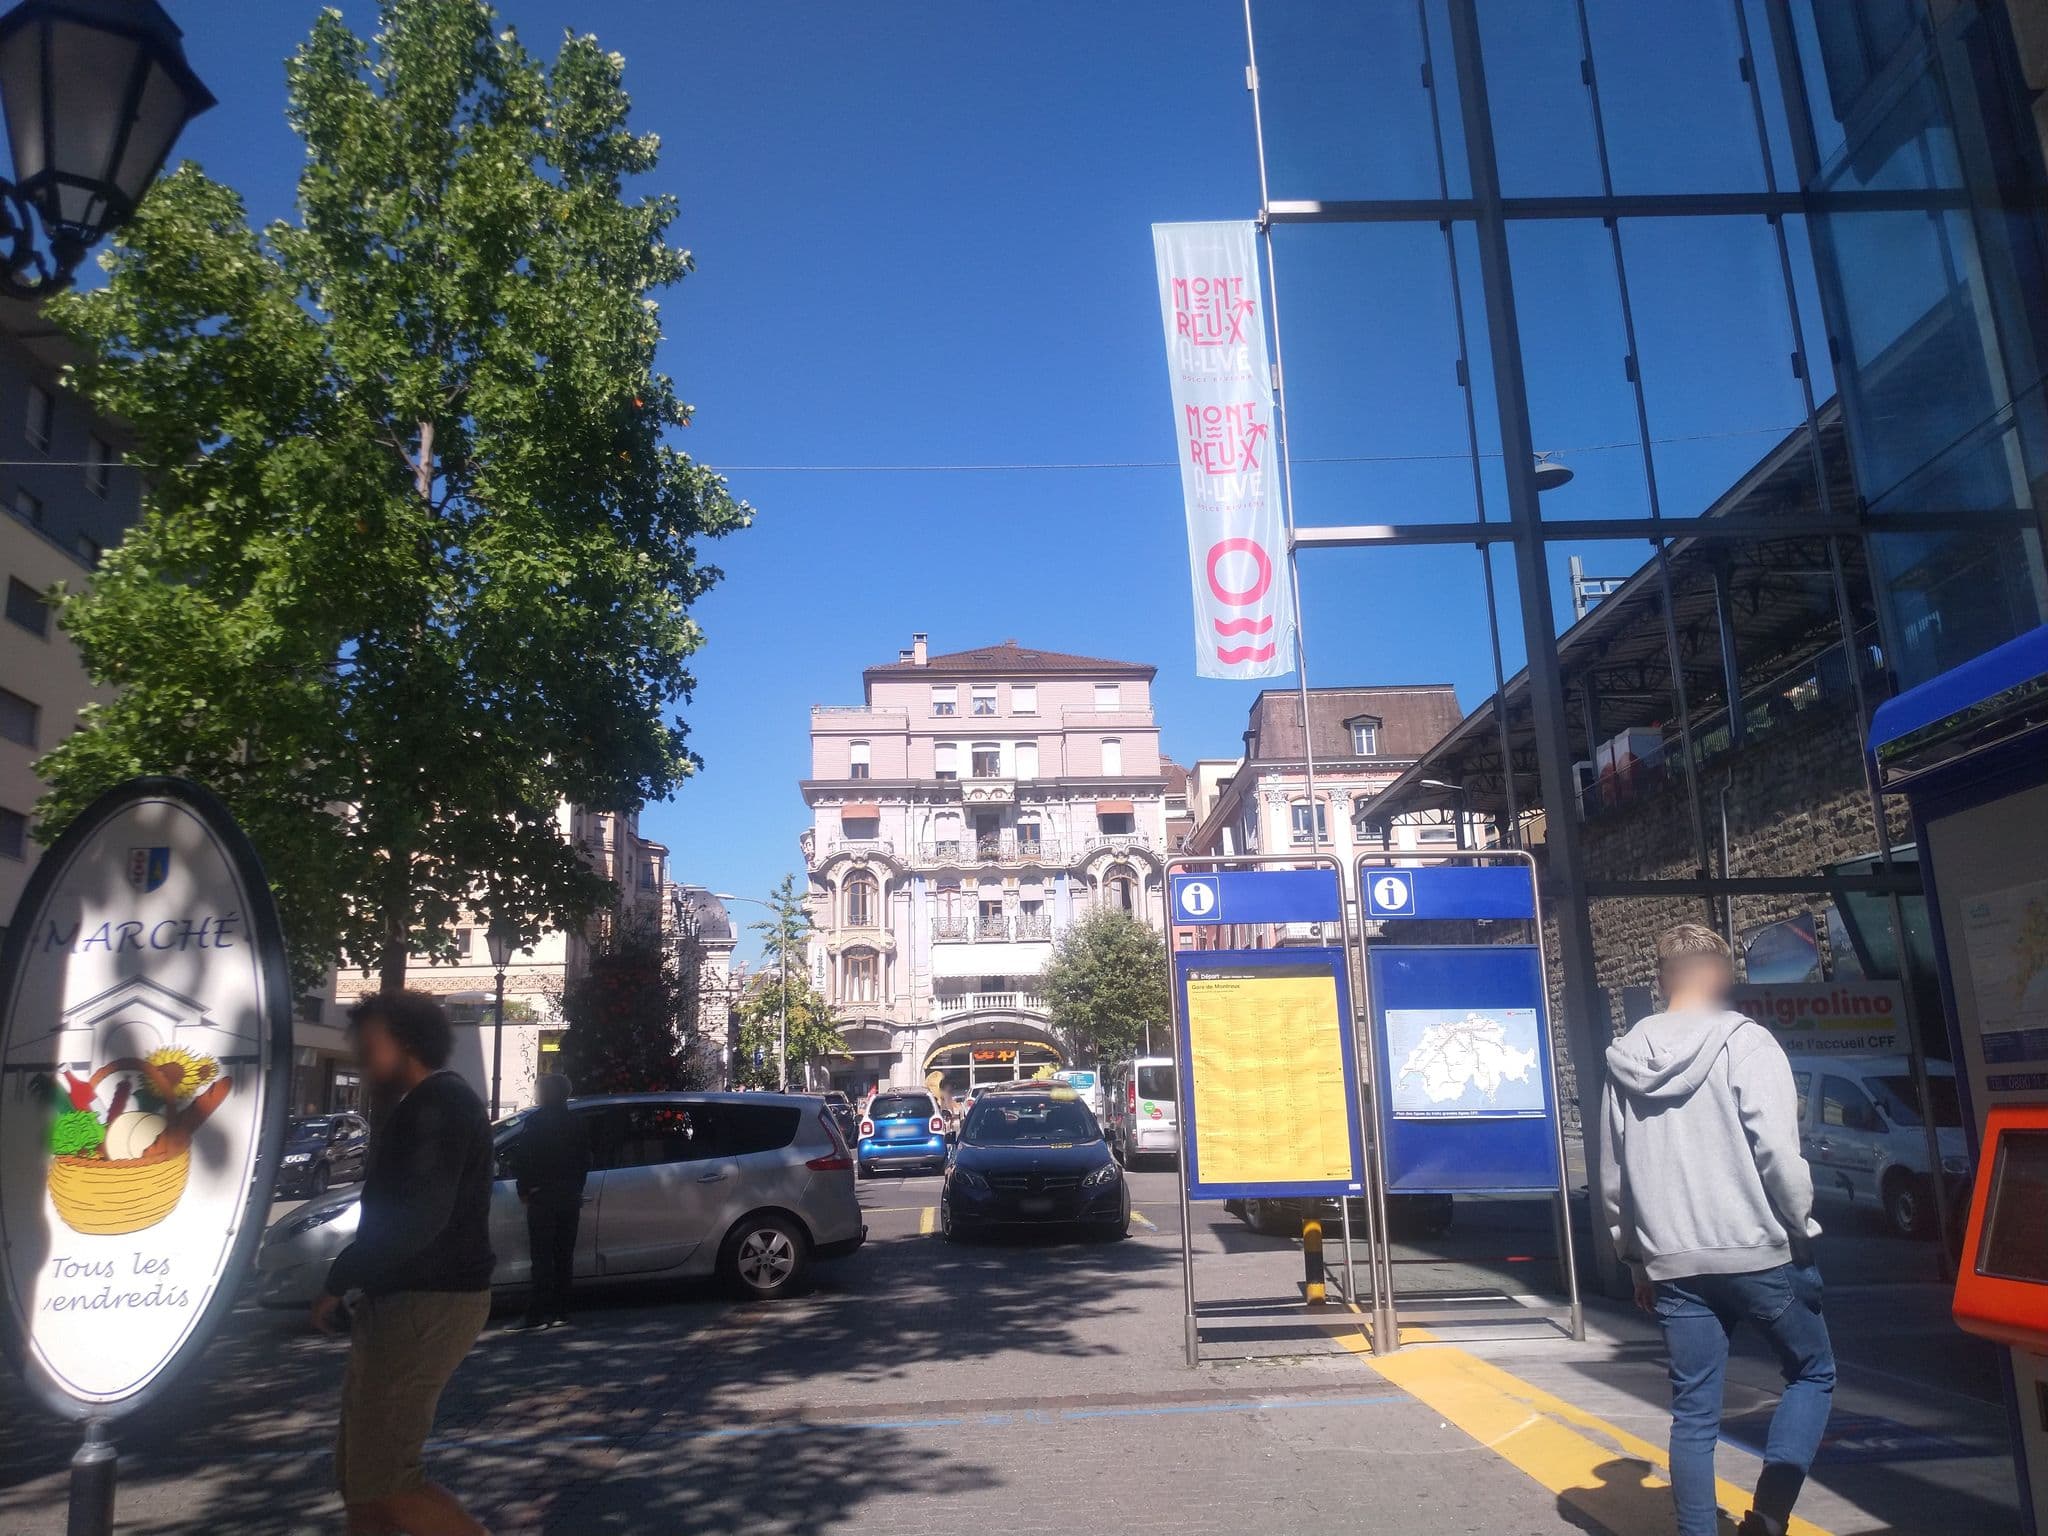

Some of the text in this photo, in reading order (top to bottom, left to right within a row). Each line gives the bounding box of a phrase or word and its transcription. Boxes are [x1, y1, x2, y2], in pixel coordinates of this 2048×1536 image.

[1171, 277, 1244, 310] MONT
[1185, 402, 1256, 439] MONT
[46, 912, 241, 954] MARCHÉ
[1736, 988, 1893, 1025] migrolino
[1787, 1035, 1897, 1050] de l'accueil CFF
[52, 1252, 170, 1278] Tous les
